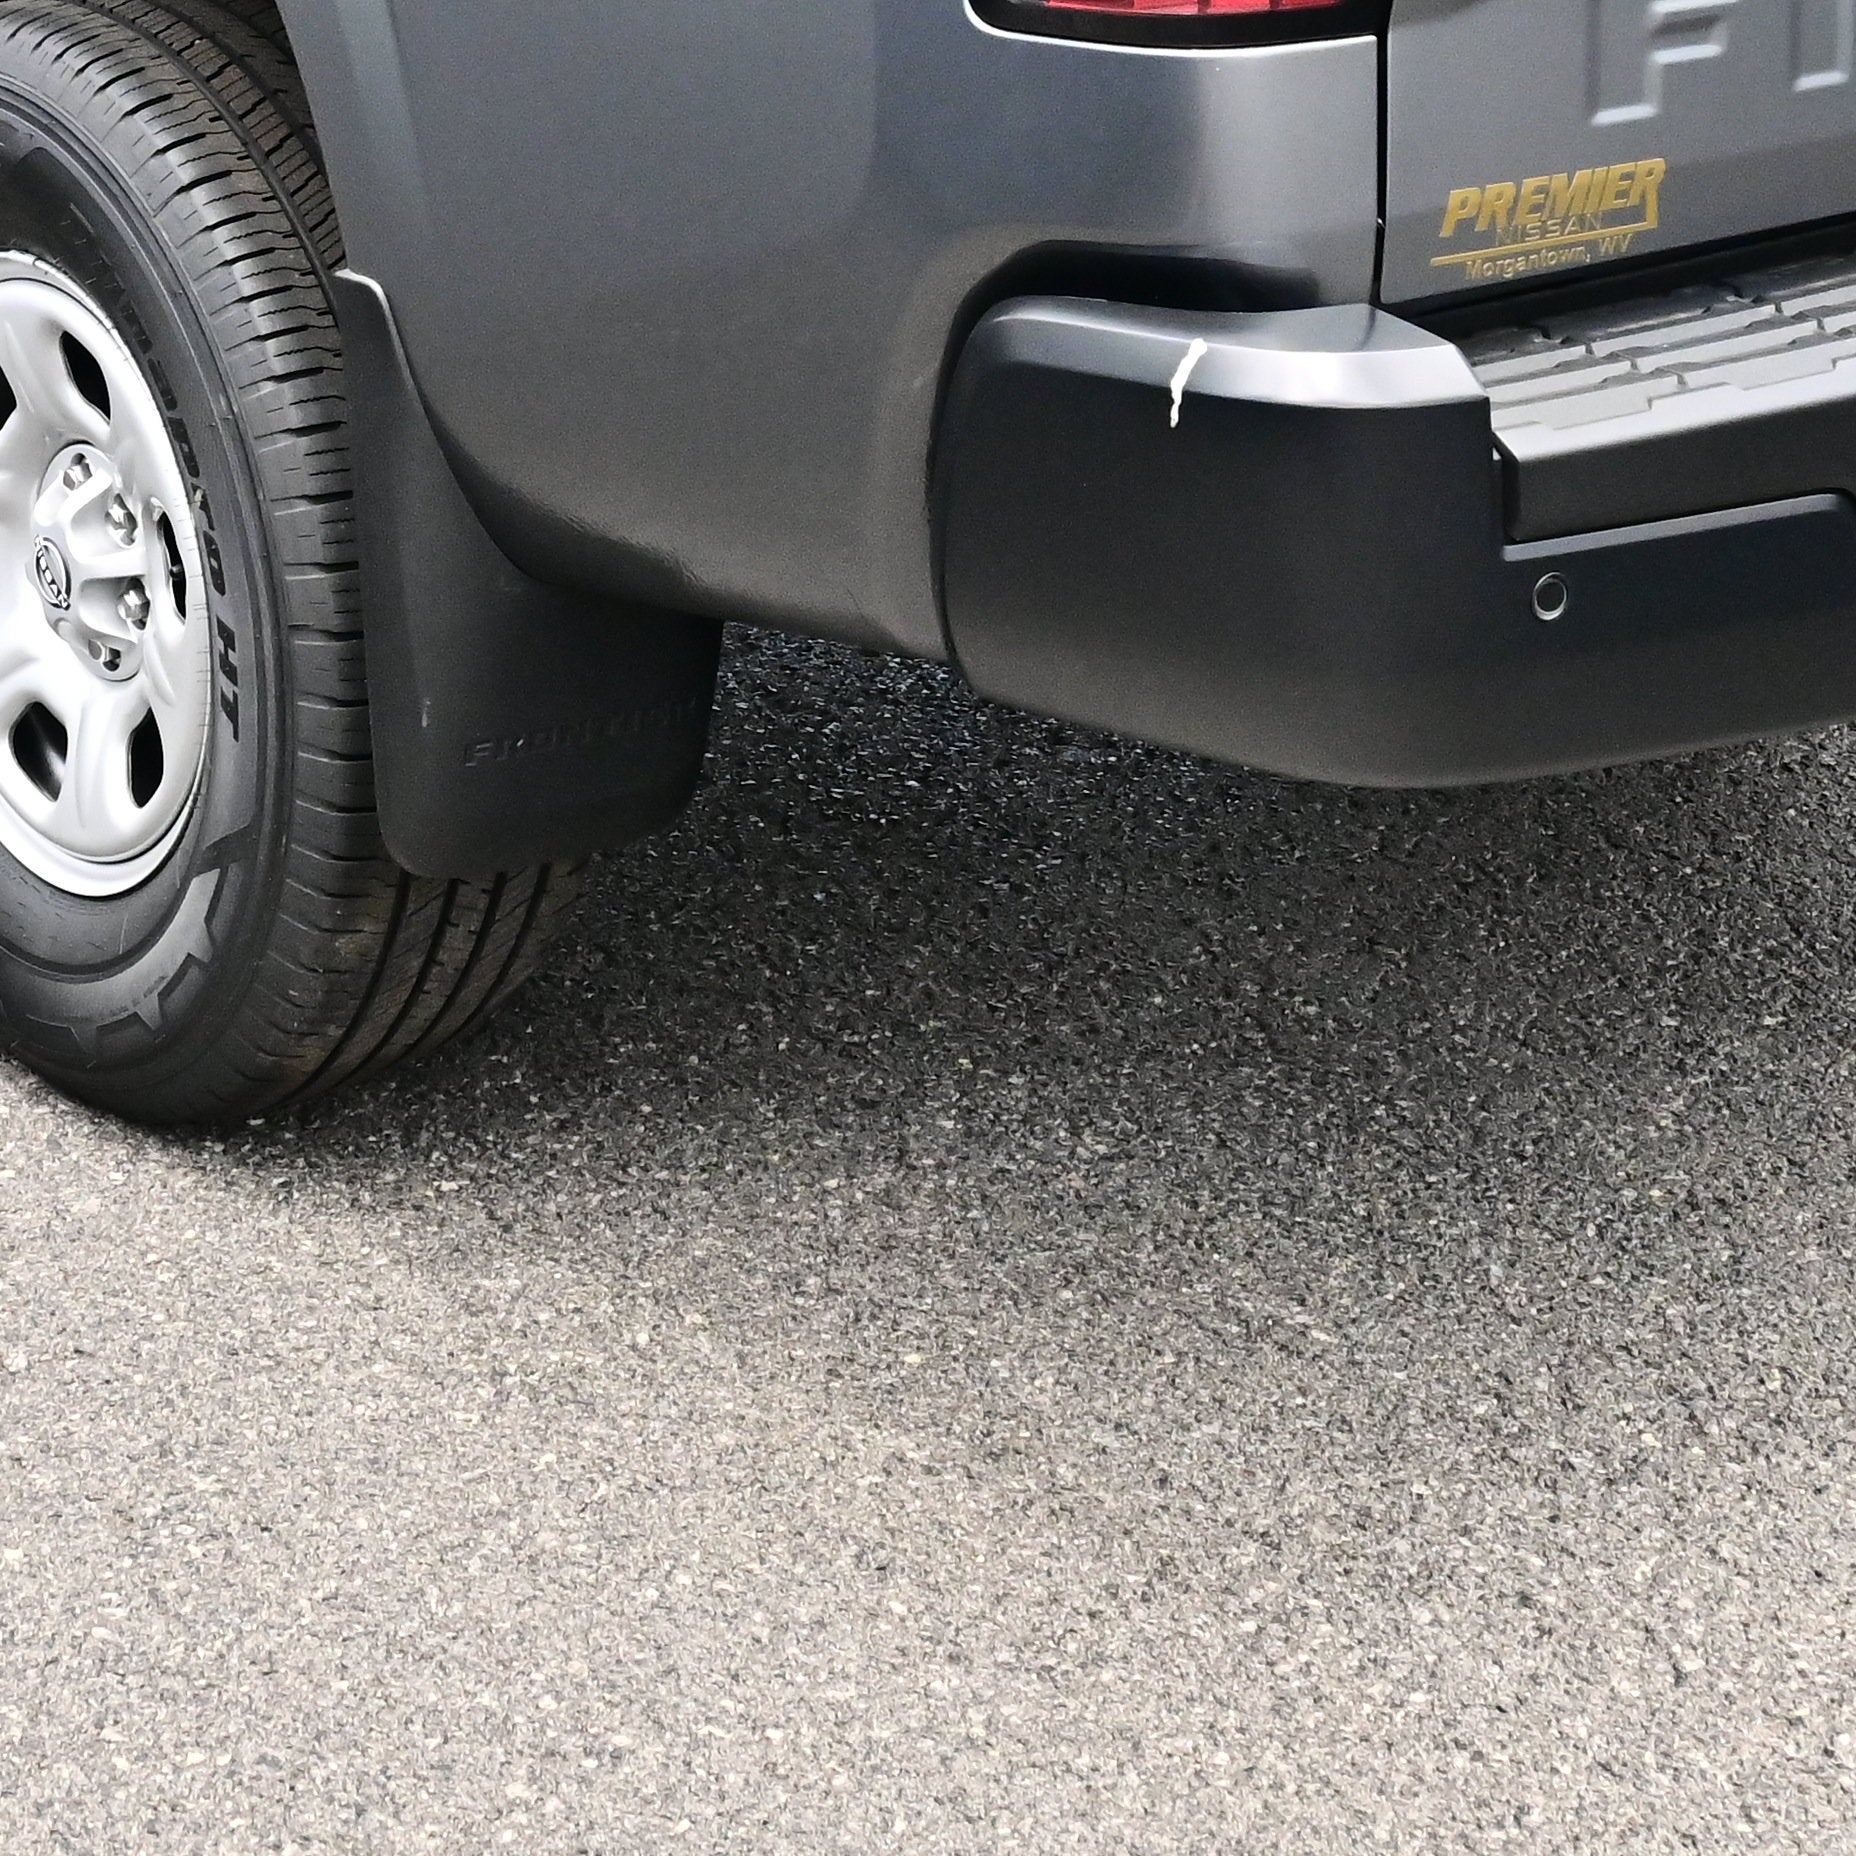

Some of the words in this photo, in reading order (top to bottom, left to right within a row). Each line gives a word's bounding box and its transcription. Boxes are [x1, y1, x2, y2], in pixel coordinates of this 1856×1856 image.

[1438, 157, 1666, 238] PREMIER
[1495, 211, 1604, 247] NISSAN
[1464, 244, 1592, 281] Morgantown,
[1598, 232, 1634, 258] WV
[215, 613, 241, 744] HT
